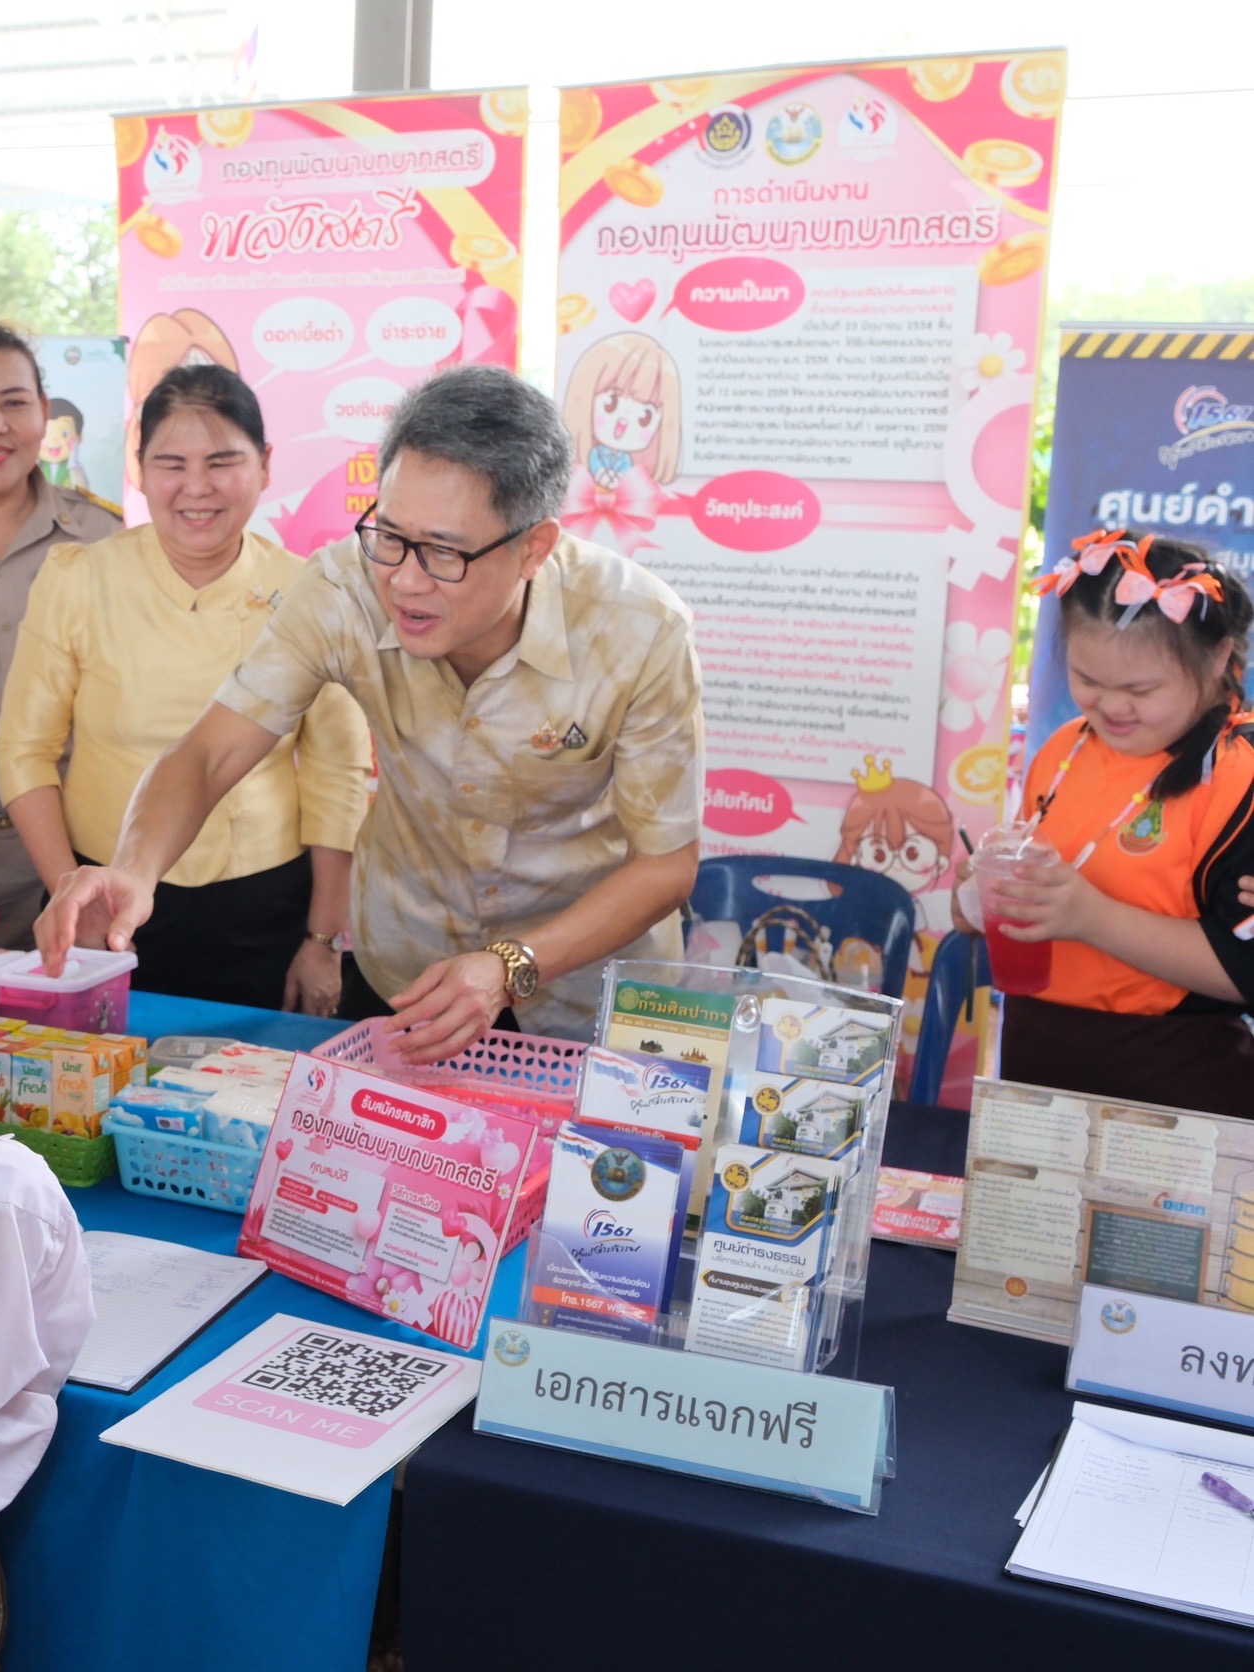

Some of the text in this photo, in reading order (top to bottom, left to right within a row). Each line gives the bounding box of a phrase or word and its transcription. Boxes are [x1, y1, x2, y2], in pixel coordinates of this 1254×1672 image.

[222, 142, 483, 187] กองทุนพัฒนาบทบาทสตรี
[714, 179, 869, 206] การดำเนินงาน
[204, 187, 419, 258] พลังสตรี
[597, 205, 999, 260] กองทุนพัฒนาบทบาทสตรี
[690, 279, 790, 303] ความเป็นมา
[263, 319, 345, 343] ดอกเบี้ยต่ำ
[380, 322, 447, 343] ชำระง่าย
[705, 497, 804, 524] วัตถุประสงค์
[638, 999, 729, 1024] กรมศิลปากร
[17, 1077, 48, 1096] fresh
[649, 1074, 687, 1089] 1567
[361, 1095, 436, 1132] รับสมัครสมาชิก
[292, 1108, 498, 1193] กองทุนพัฒนาบทบาทสตรี
[310, 1161, 349, 1182] คุณสมบัติ
[589, 1220, 633, 1238] 1567
[714, 1240, 807, 1266] ศูนย์ดำรงธรรม
[560, 1291, 604, 1310] โทร.1567
[215, 1393, 364, 1442] SCAN ME
[534, 1367, 818, 1450] เอกสารแจกฟรี
